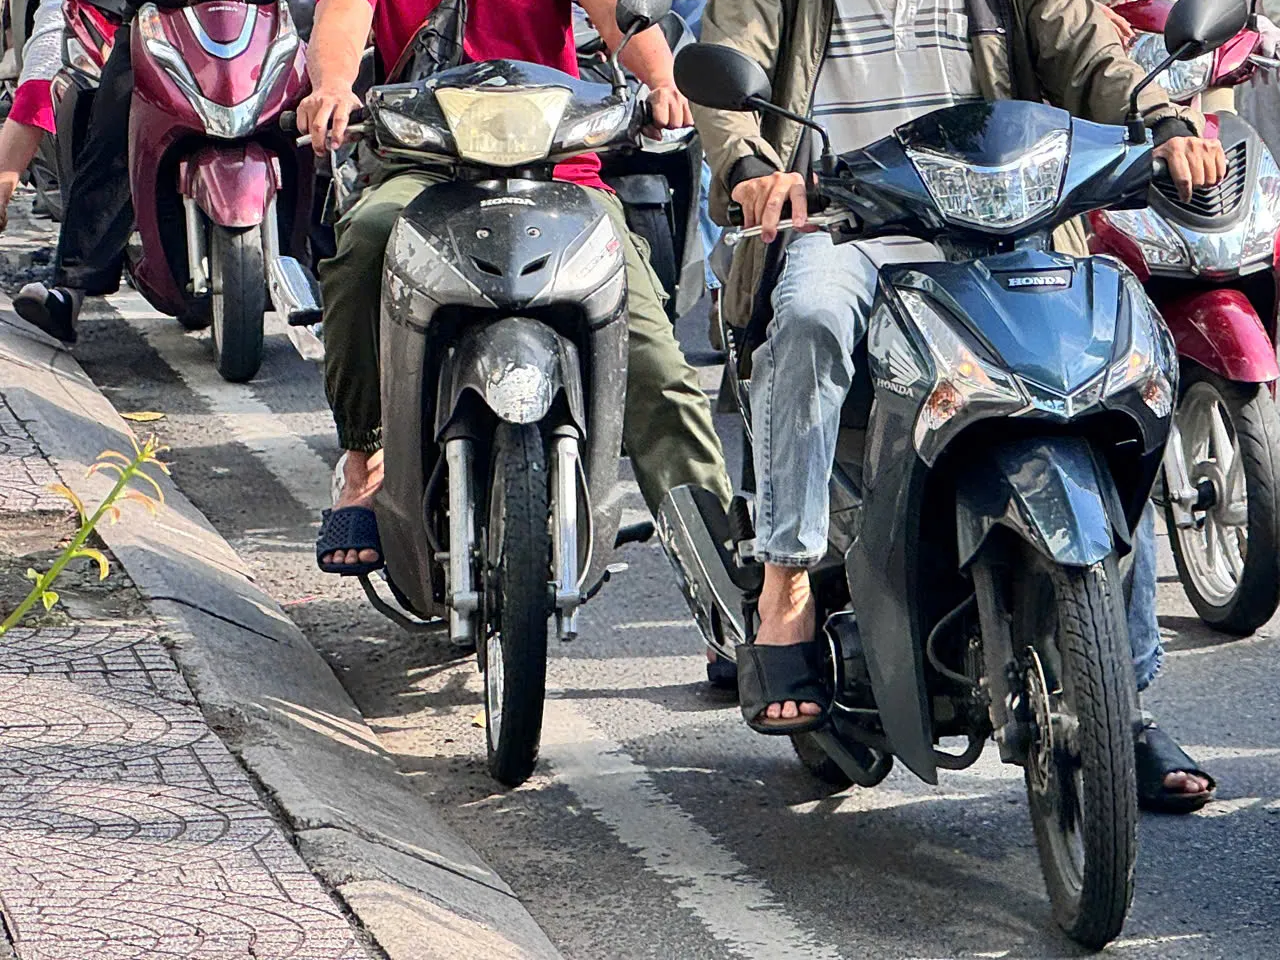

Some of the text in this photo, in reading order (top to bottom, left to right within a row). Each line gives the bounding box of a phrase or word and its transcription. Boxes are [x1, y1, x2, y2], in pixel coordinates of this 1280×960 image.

[480, 196, 537, 208] HONDA
[1008, 275, 1066, 287] HONDA
[876, 377, 915, 398] HONDA
